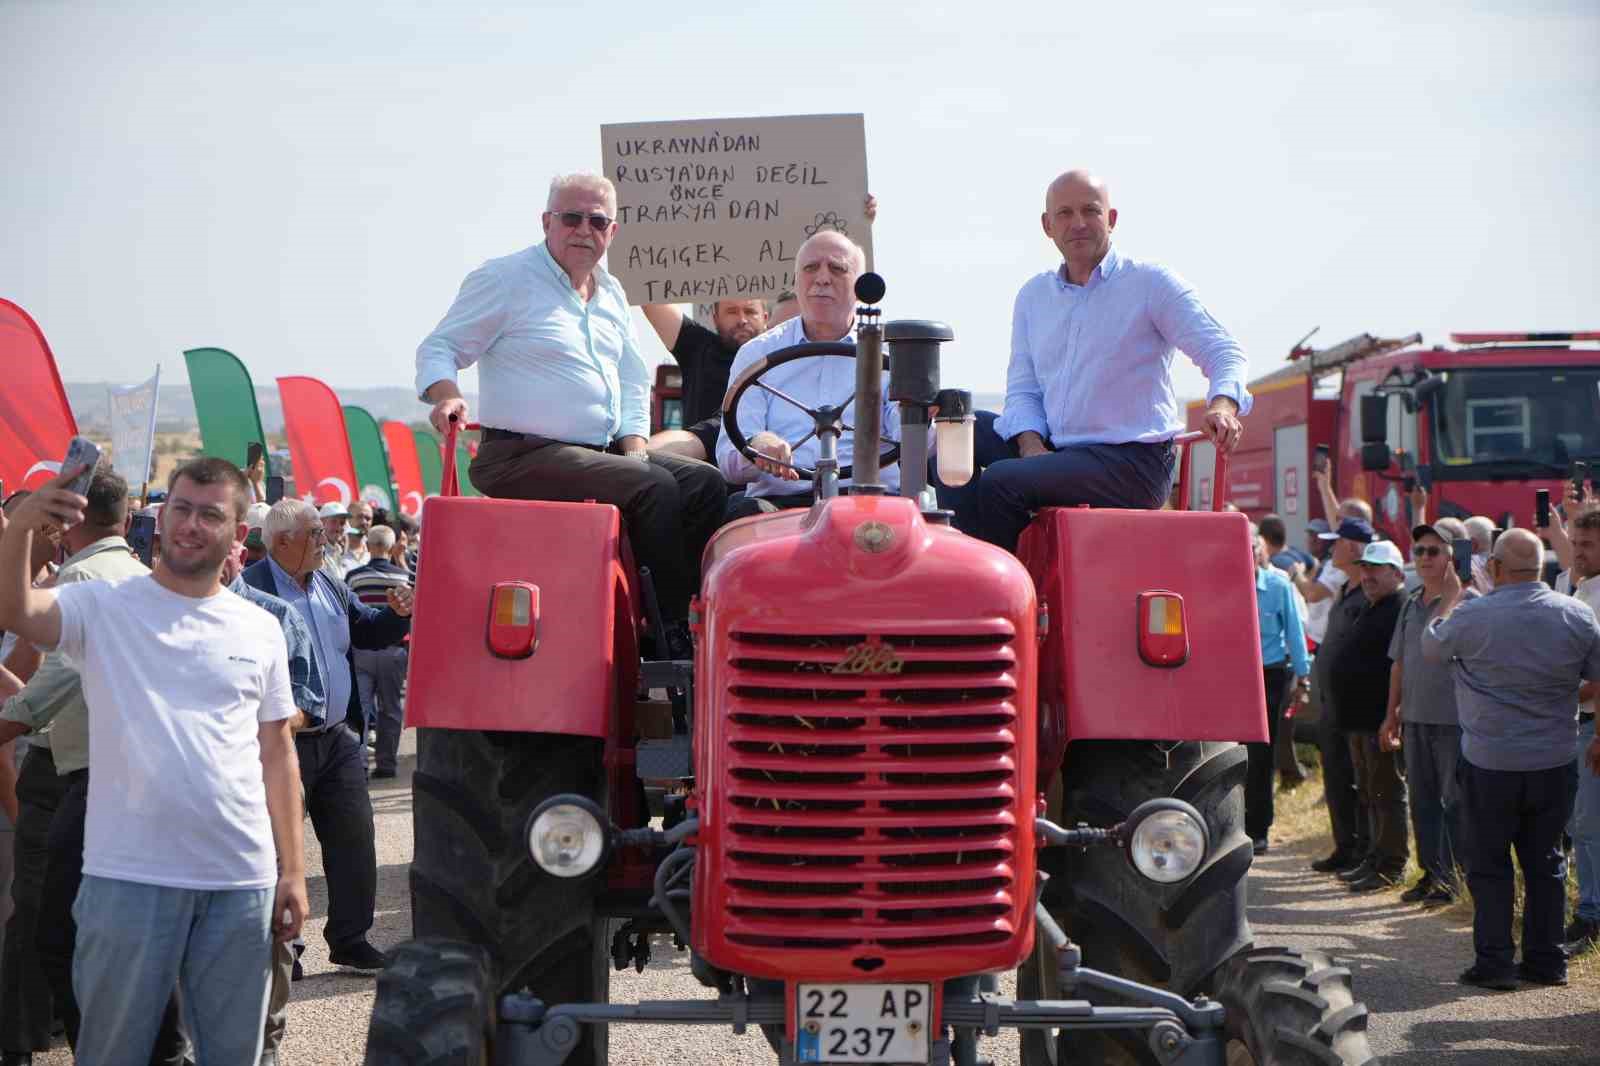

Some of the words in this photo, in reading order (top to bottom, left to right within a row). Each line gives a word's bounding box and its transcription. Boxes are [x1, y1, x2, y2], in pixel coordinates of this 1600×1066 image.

[616, 131, 760, 157] UKRAYNA'DAN
[616, 163, 735, 183] RUSYA'DAN
[756, 161, 828, 184] DEĞİL
[805, 989, 849, 1018] 22
[879, 989, 922, 1018] AP
[828, 1027, 896, 1057] 237
